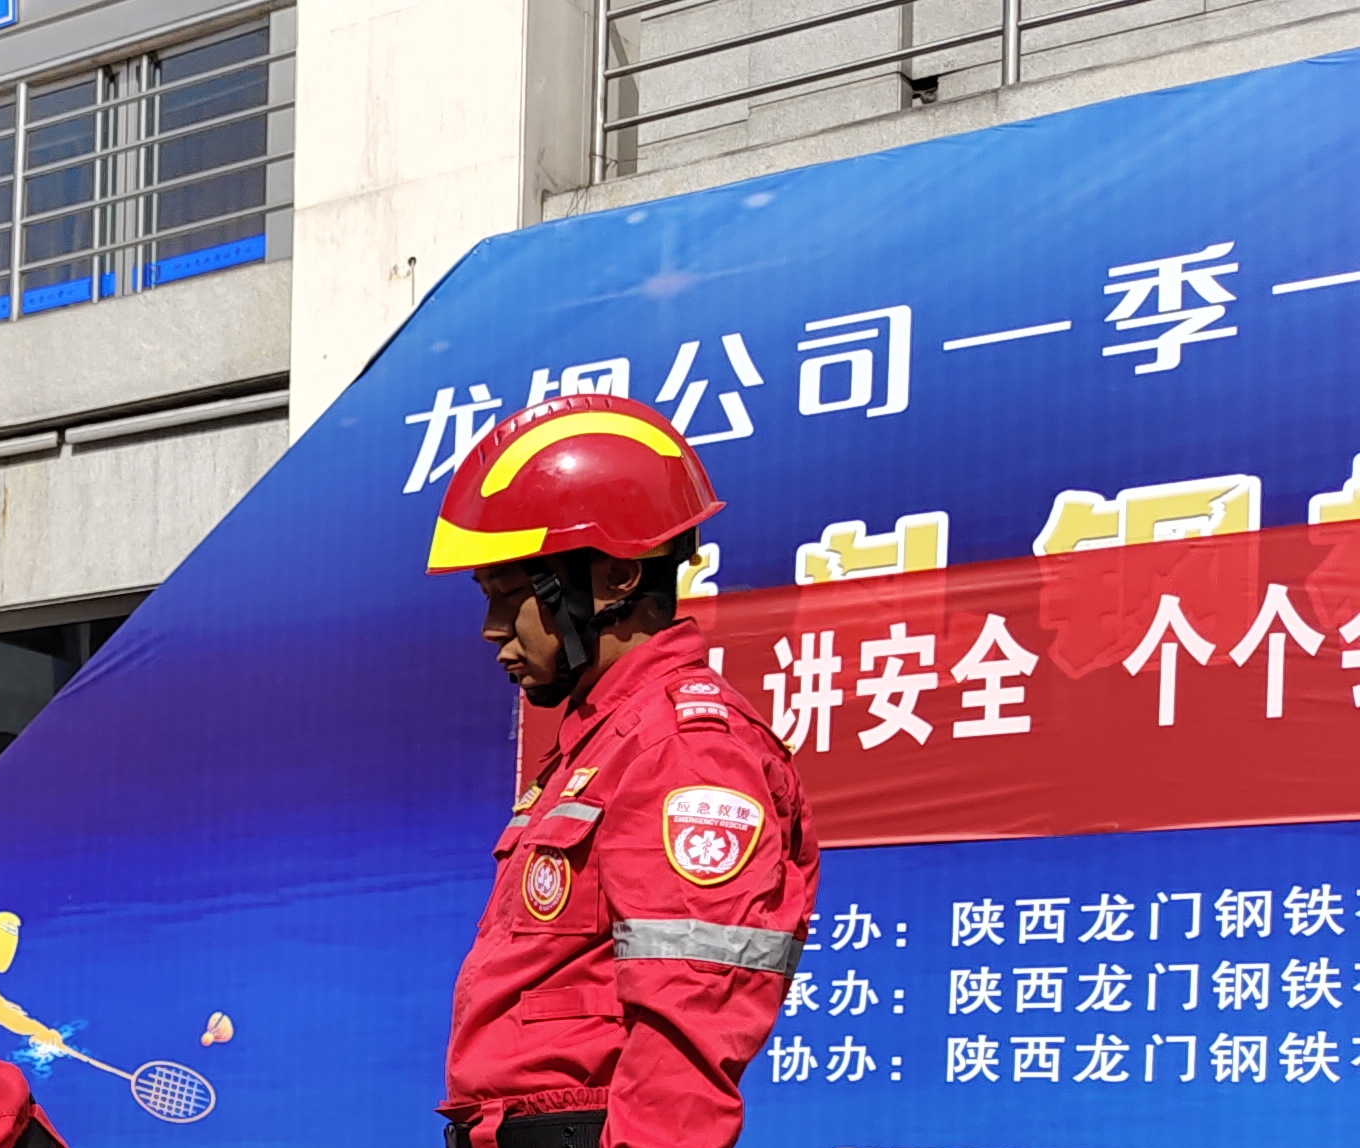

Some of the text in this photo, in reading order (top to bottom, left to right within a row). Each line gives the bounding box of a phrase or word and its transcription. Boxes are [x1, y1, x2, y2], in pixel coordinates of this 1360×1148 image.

[709, 582, 1360, 754] 讲安全 个个
